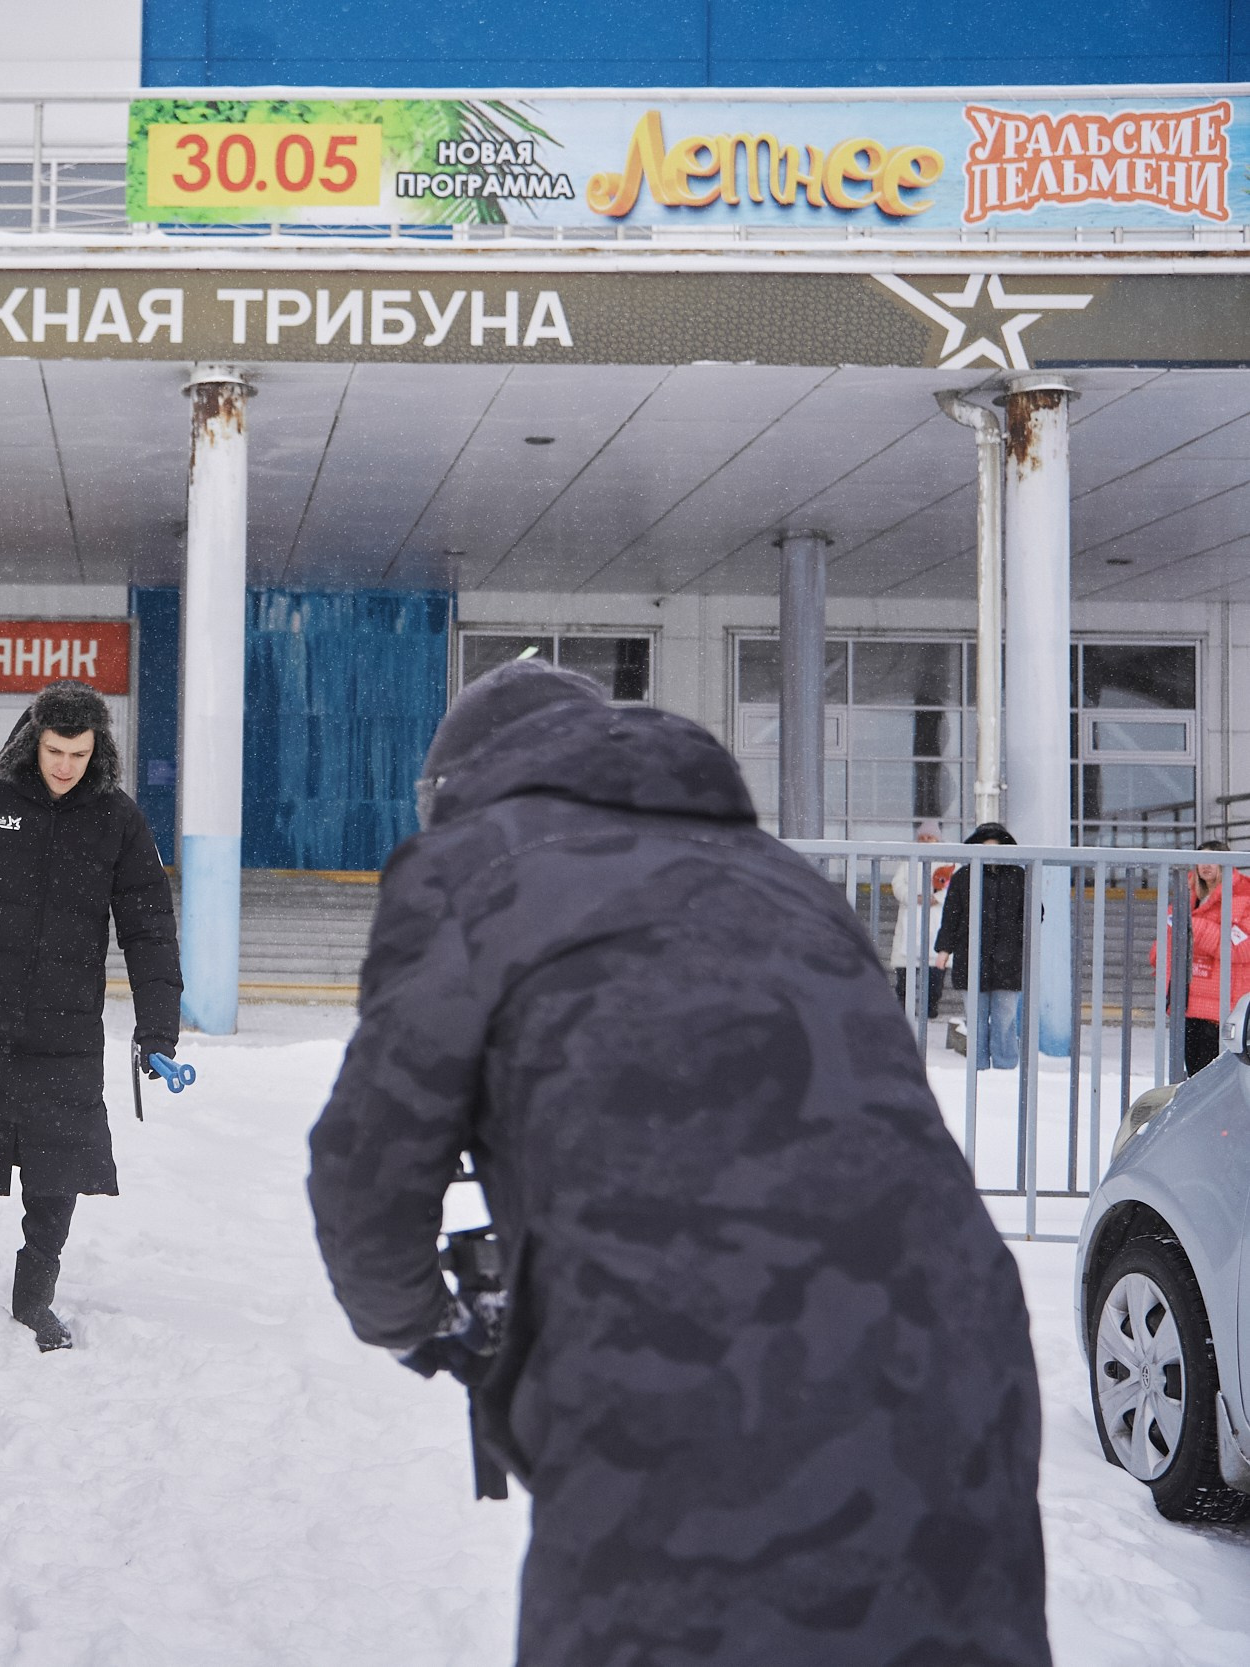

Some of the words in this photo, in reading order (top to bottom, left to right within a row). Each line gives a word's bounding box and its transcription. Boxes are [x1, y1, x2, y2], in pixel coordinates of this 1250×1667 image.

[172, 134, 358, 193] 30.05
[437, 139, 535, 167] НОВАЯ
[586, 110, 945, 216] Летнее
[970, 107, 1225, 161] УРАЛЬСКИЕ
[396, 171, 574, 200] ПРОГРАММА
[969, 156, 1223, 219] ПЕЛЬМЕНИ
[216, 288, 575, 348] ТРИБУНА
